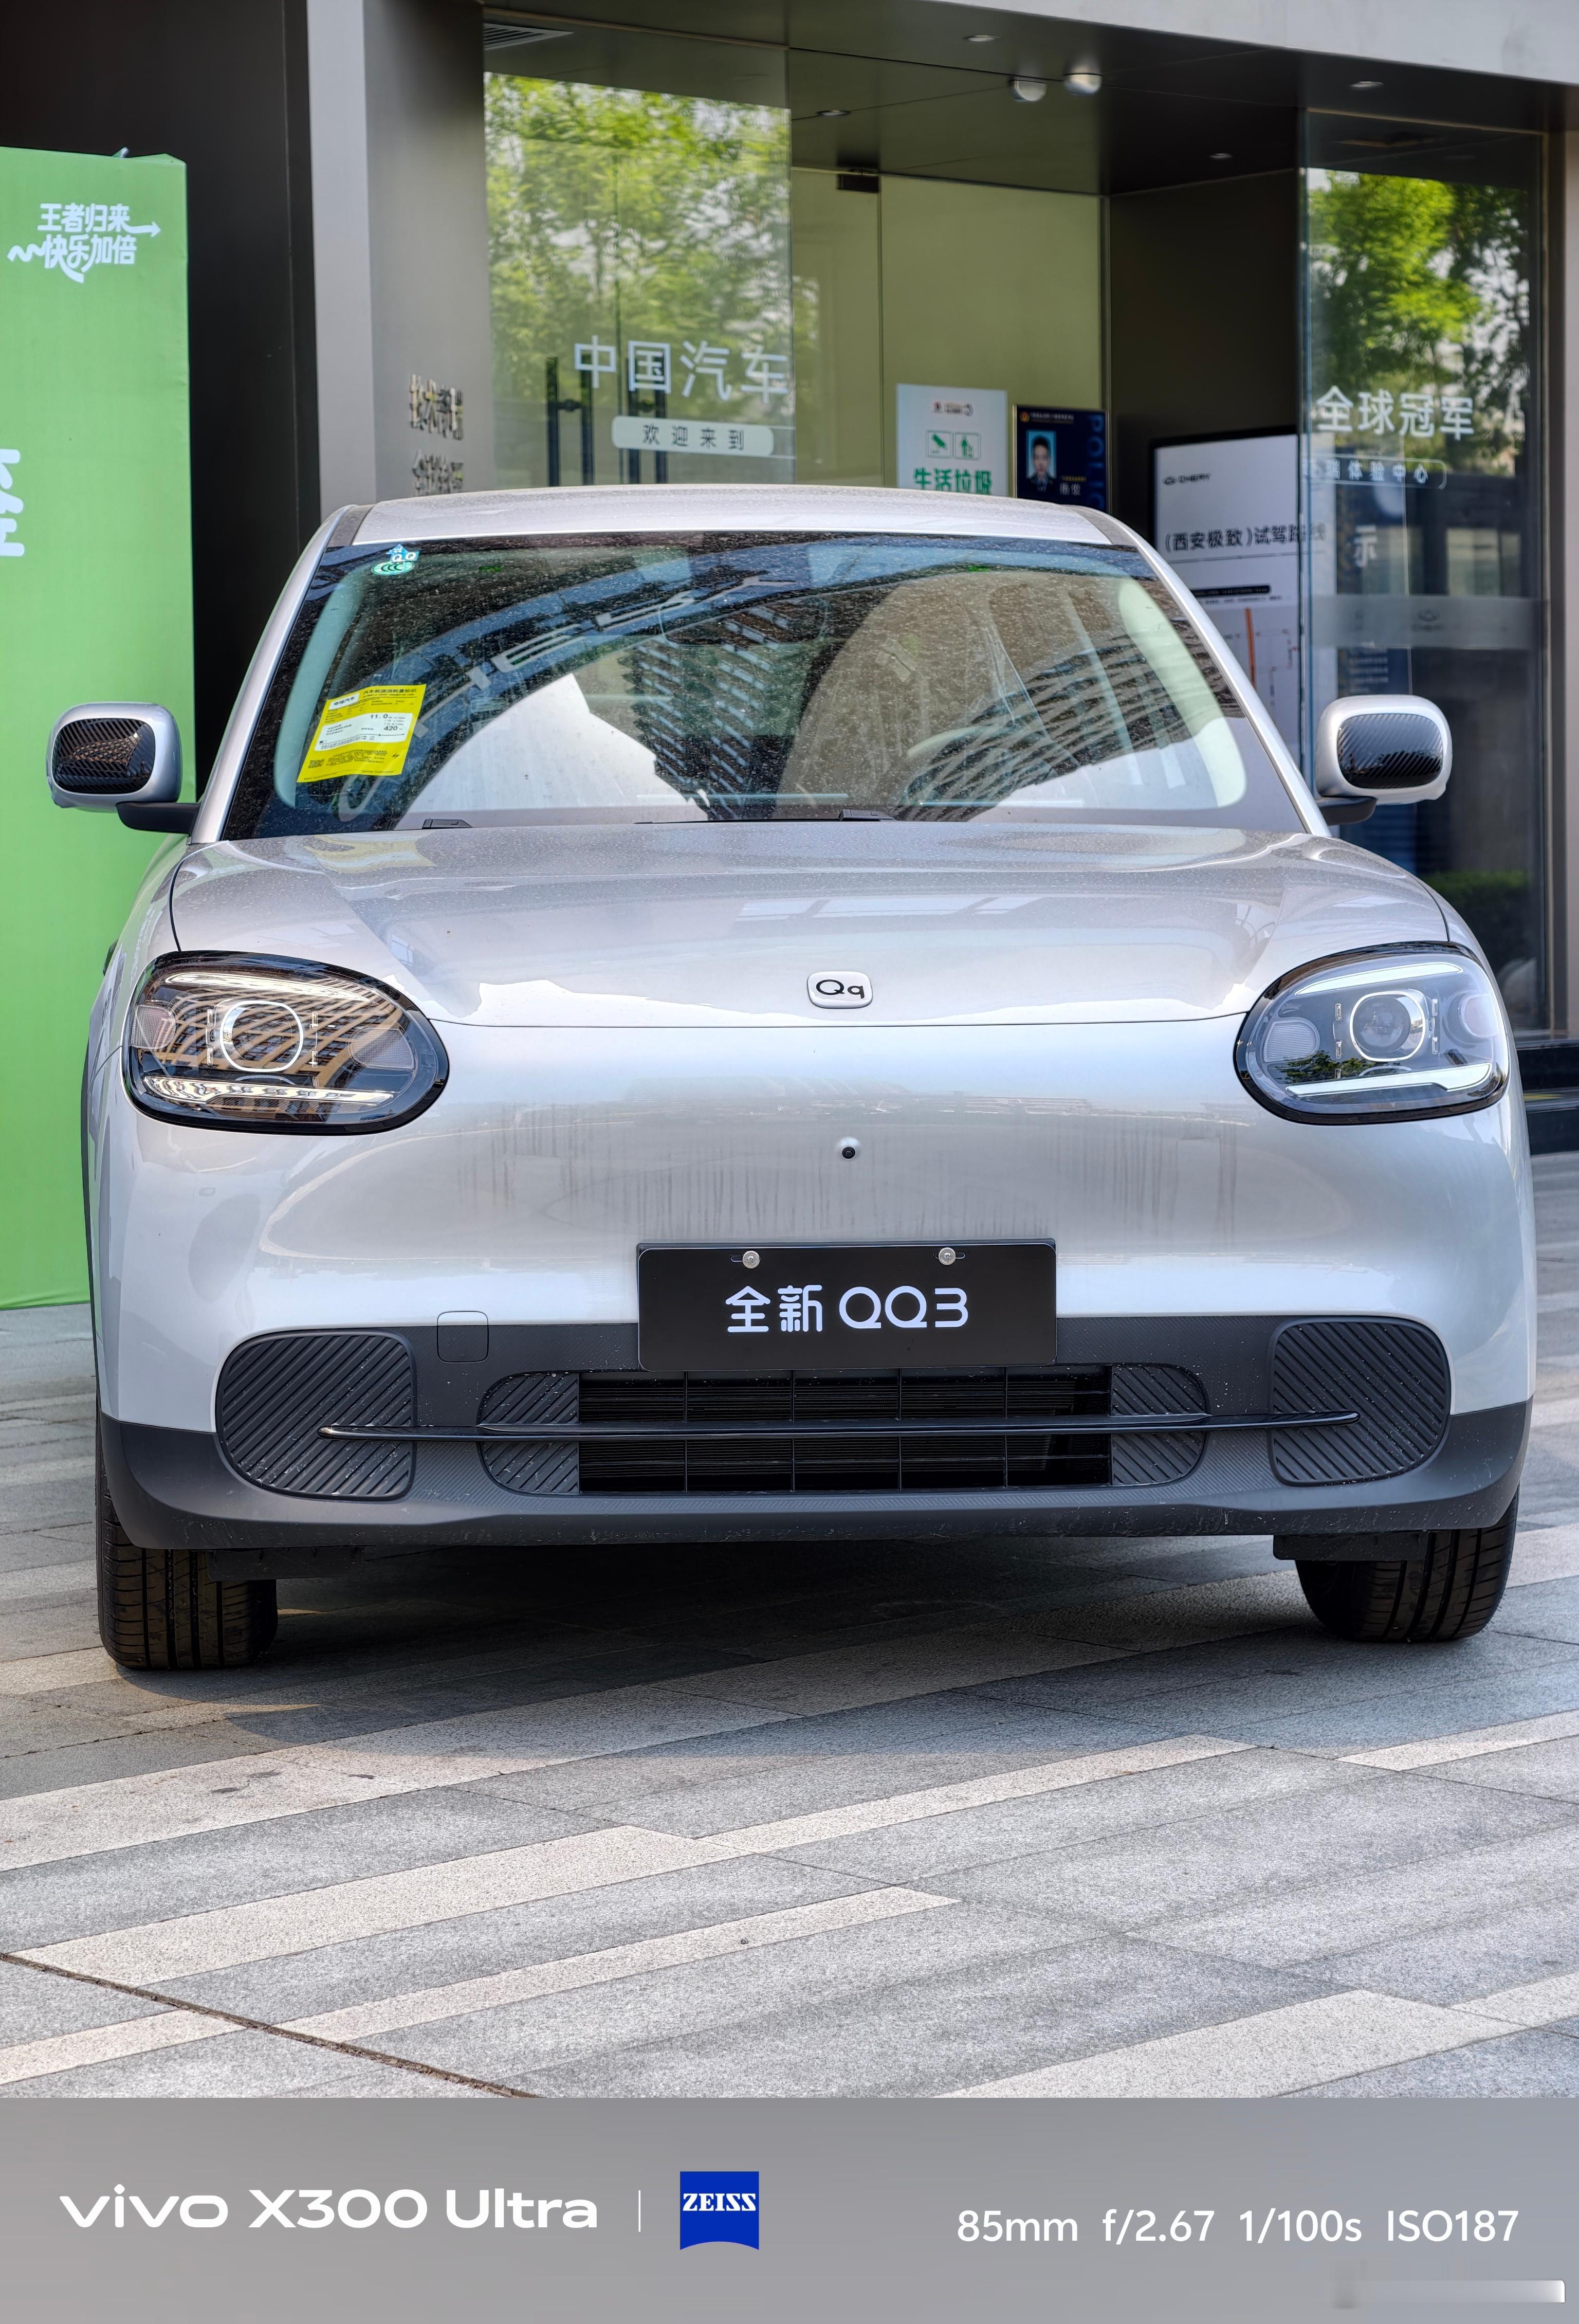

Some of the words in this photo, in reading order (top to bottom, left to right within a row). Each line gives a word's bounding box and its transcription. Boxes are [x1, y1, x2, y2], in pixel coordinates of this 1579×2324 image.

[38, 202, 131, 233] 王者归来
[44, 233, 137, 283] 快乐加倍
[574, 335, 790, 404] 中国汽车
[1316, 385, 1475, 441] 全球冠军
[642, 423, 745, 451] 欢迎来到
[913, 468, 993, 495] 生活垃圾
[816, 979, 865, 999] Qq
[725, 1284, 823, 1333] 全新
[839, 1285, 968, 1329] QQ3
